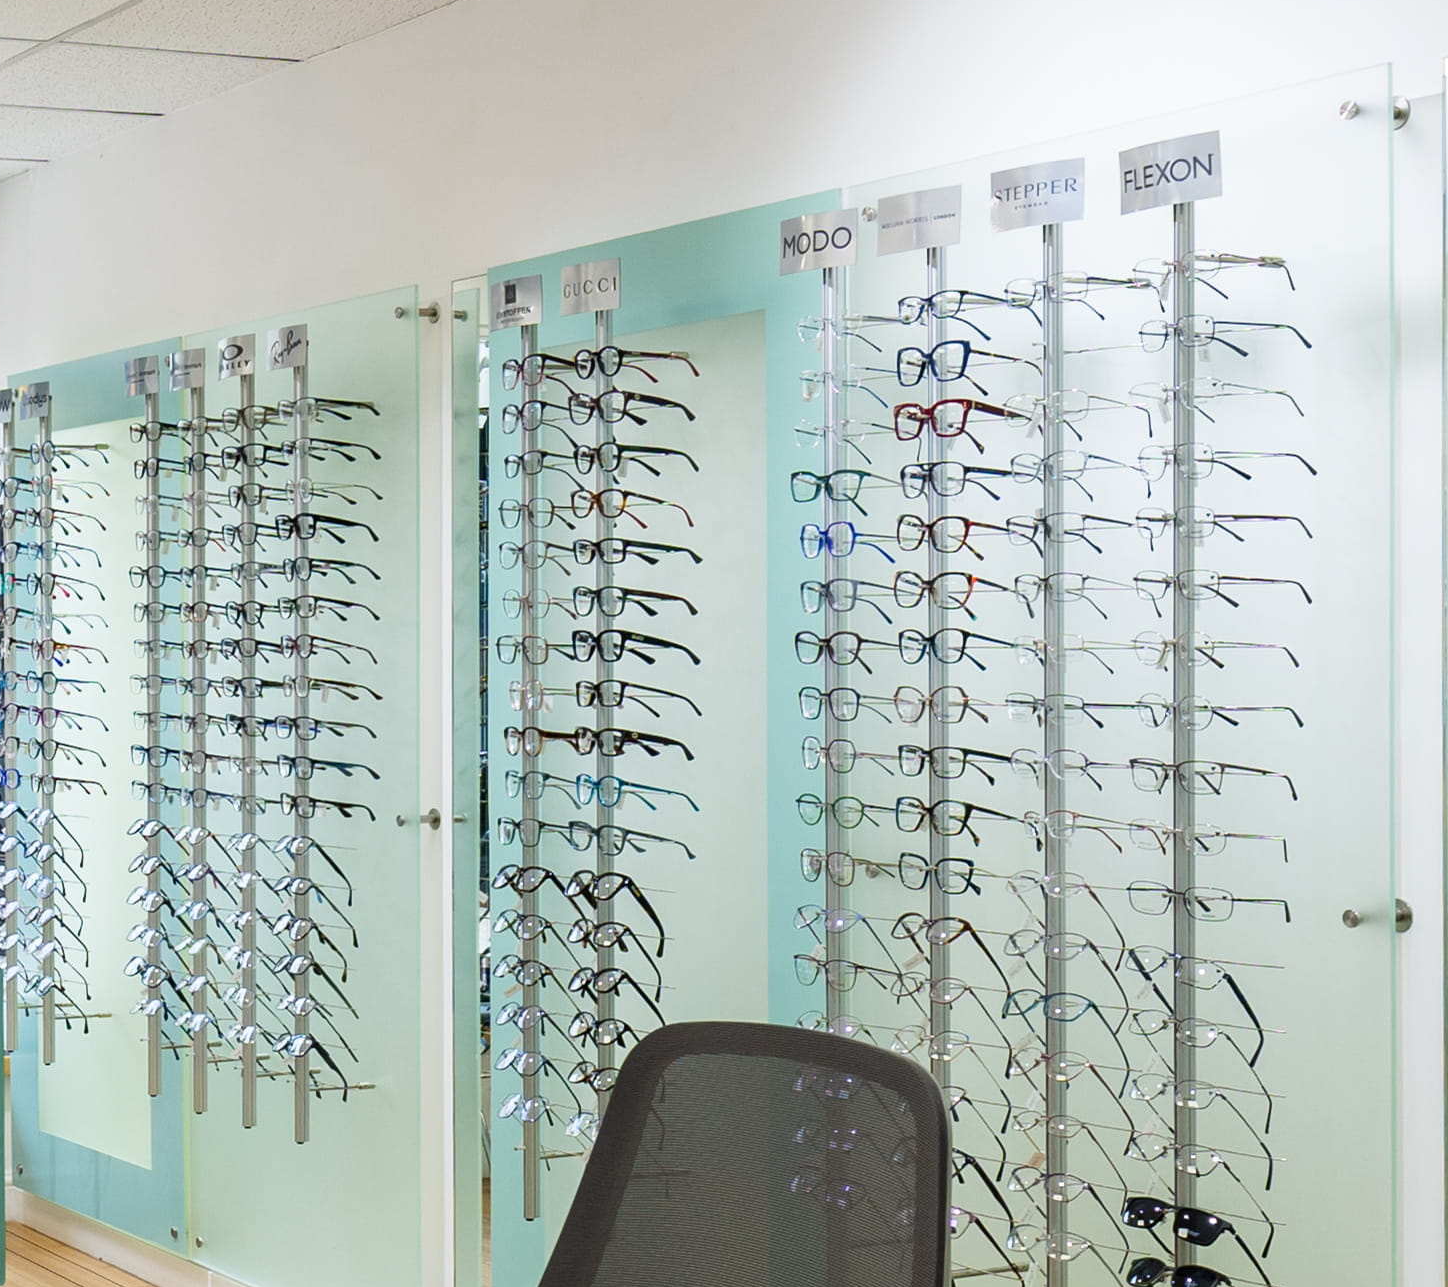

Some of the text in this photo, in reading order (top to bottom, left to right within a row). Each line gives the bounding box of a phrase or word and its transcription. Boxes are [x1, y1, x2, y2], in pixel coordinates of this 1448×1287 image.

[1122, 153, 1213, 194] FLEXON
[992, 177, 1078, 203] STEPPER
[782, 225, 853, 259] MODO
[563, 276, 617, 300] GUCCI
